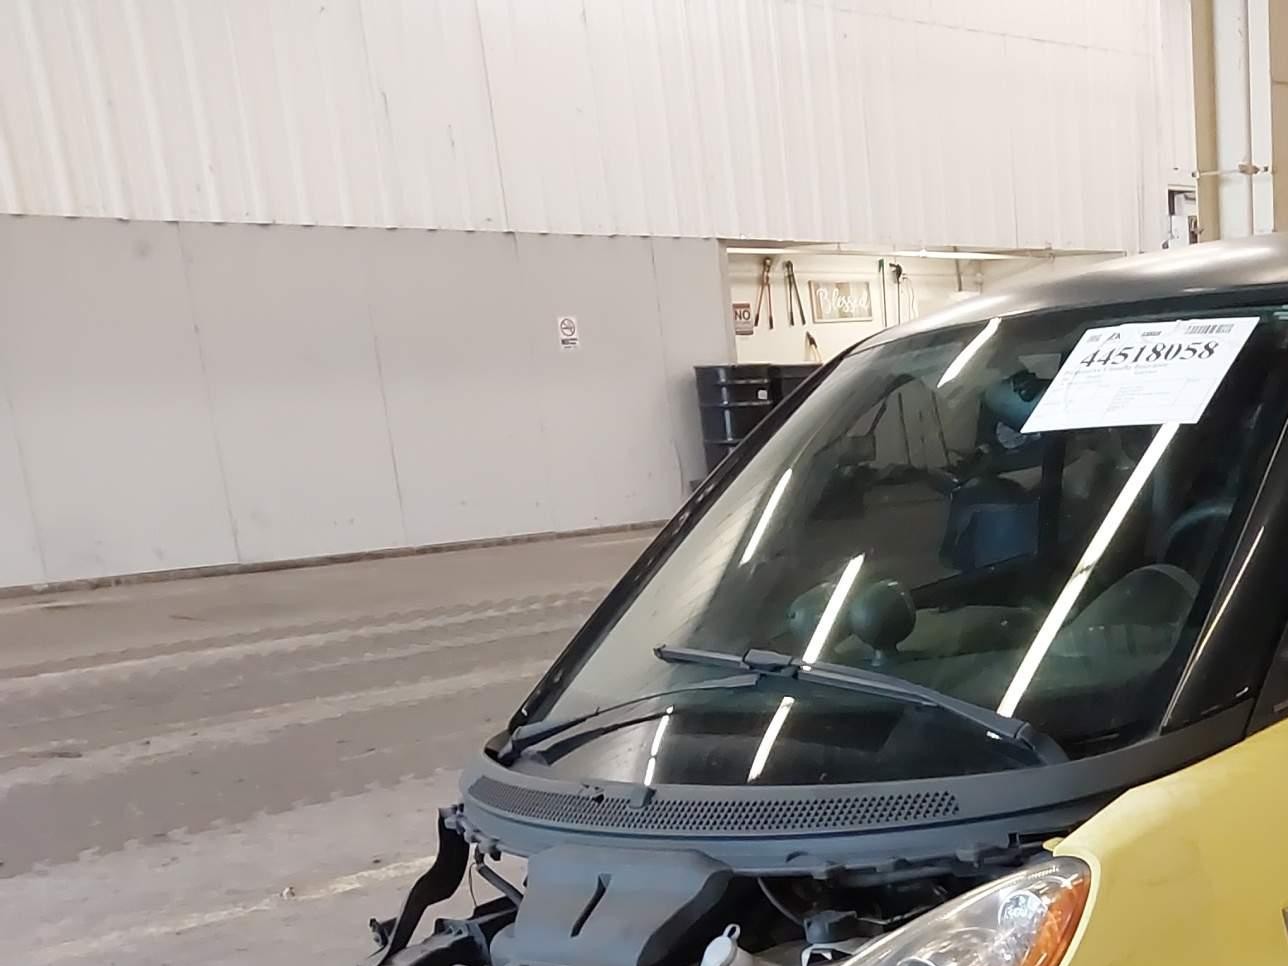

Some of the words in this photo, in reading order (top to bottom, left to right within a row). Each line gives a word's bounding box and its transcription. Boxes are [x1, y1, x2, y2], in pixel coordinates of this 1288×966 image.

[816, 287, 869, 313] Blessed
[735, 310, 751, 320] NO
[1080, 341, 1219, 367] 44518058
